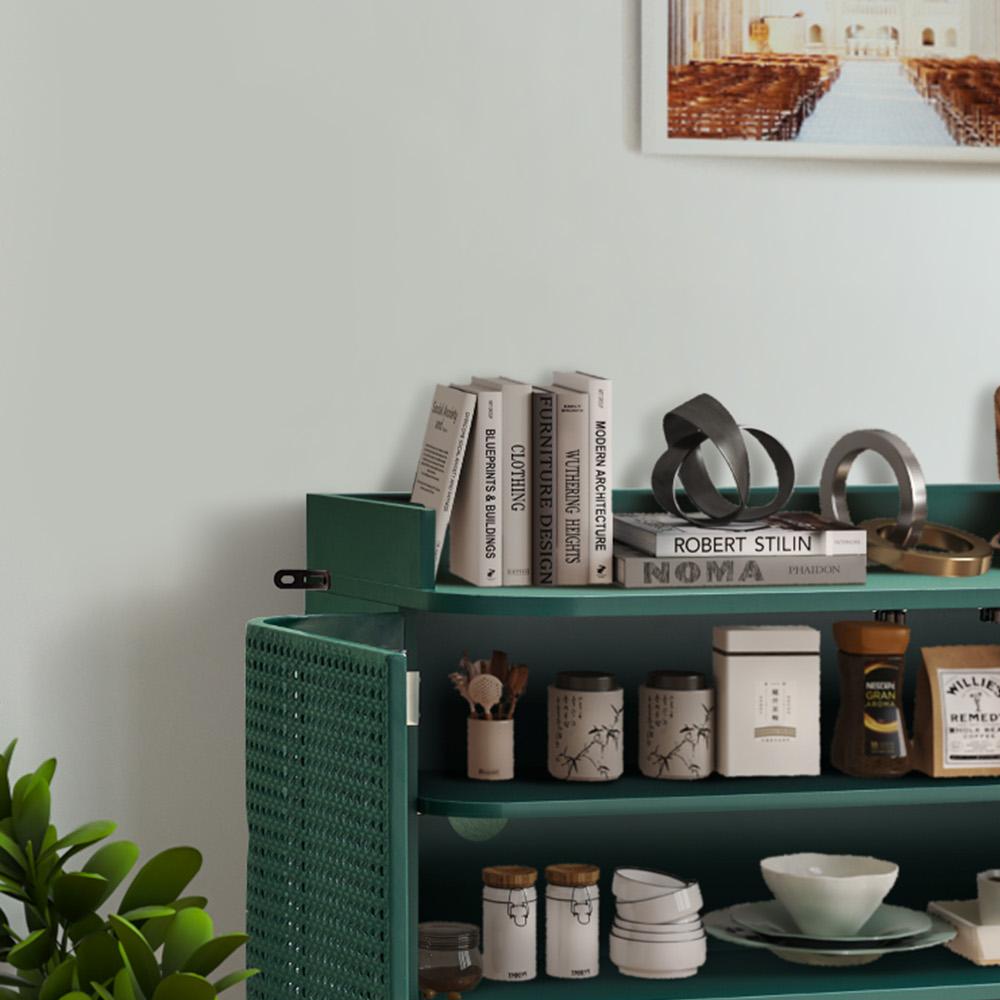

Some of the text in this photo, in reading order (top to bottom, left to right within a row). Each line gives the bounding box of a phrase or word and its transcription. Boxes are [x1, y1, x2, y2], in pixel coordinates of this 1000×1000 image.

[485, 429, 496, 494] BLUEPRINTS
[595, 421, 607, 467] MODERN
[511, 444, 525, 511] CLOTHING
[540, 396, 553, 584] FURNITURE DESIGN
[485, 505, 496, 559] BUILDINGS
[565, 449, 581, 564] WUTHERING HEIGHTS
[595, 470, 606, 551] ARCHITECTURE
[674, 536, 812, 553] ROBERT STILIN
[788, 565, 841, 575] PHAIDON
[643, 560, 764, 585] NOMA
[865, 691, 896, 700] GRAN
